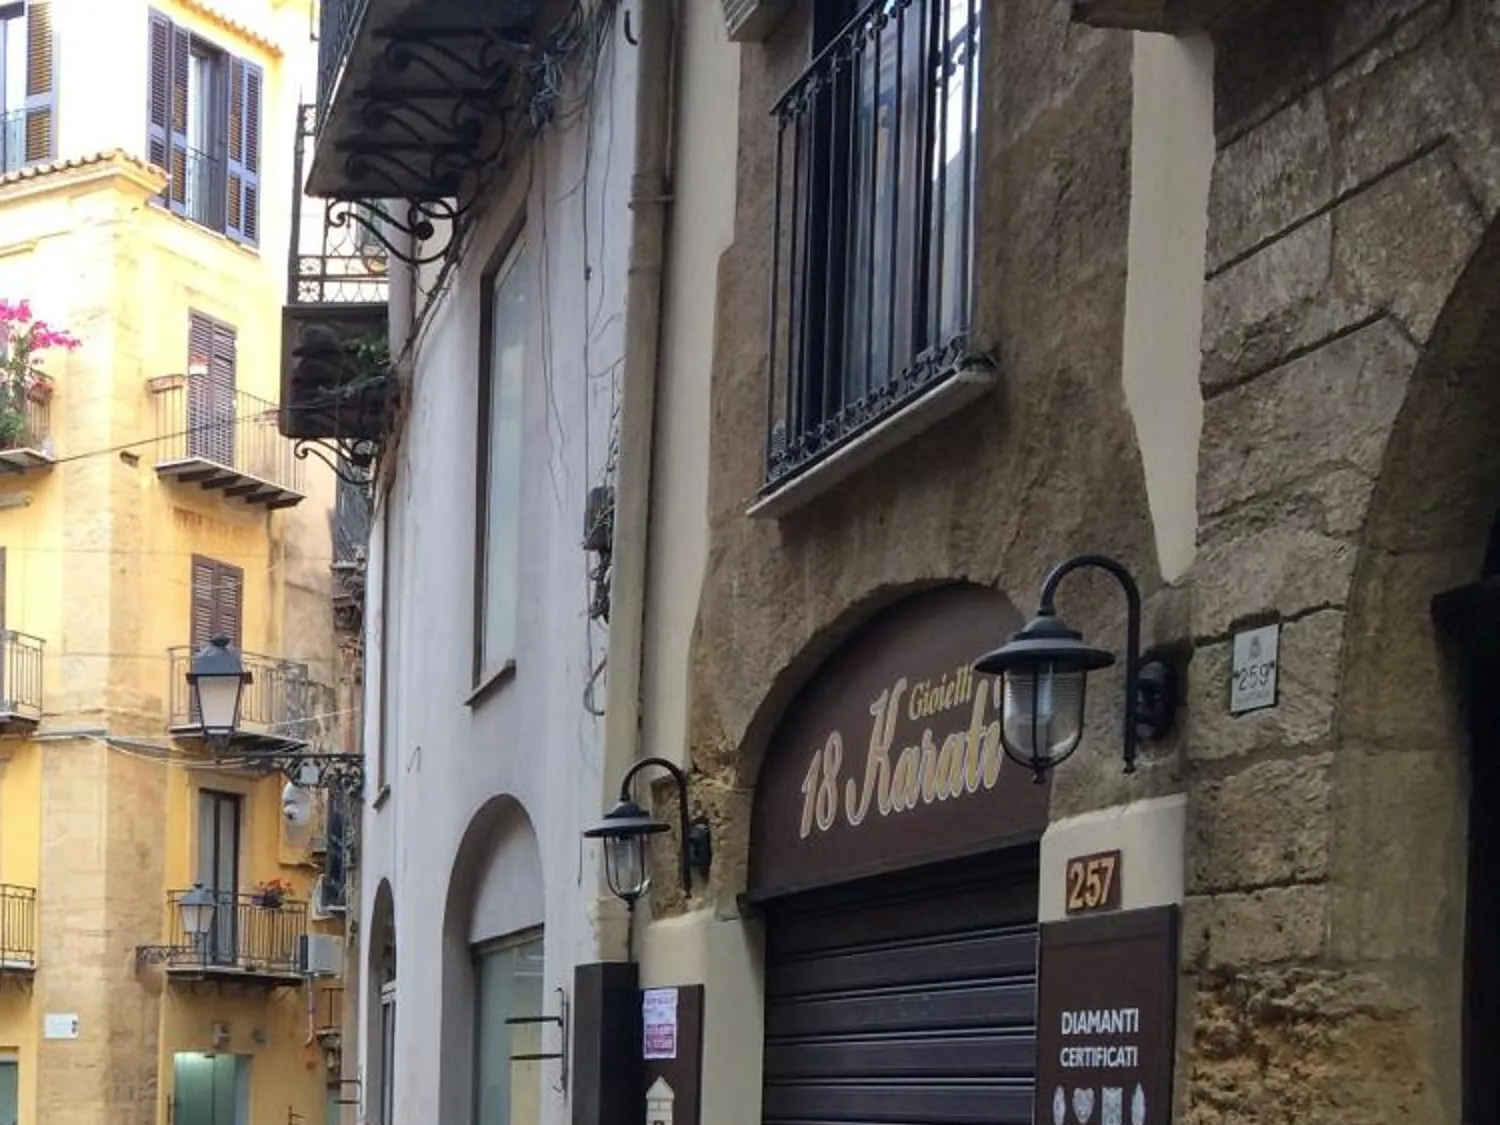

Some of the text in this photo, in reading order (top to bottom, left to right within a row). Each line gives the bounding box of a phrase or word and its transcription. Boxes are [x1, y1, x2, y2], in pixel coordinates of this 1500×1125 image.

[800, 730, 843, 840] 18
[1068, 857, 1115, 909] 257
[1061, 1008, 1139, 1035] DIAMANTI
[1060, 1046, 1139, 1068] CERTIFICATI
